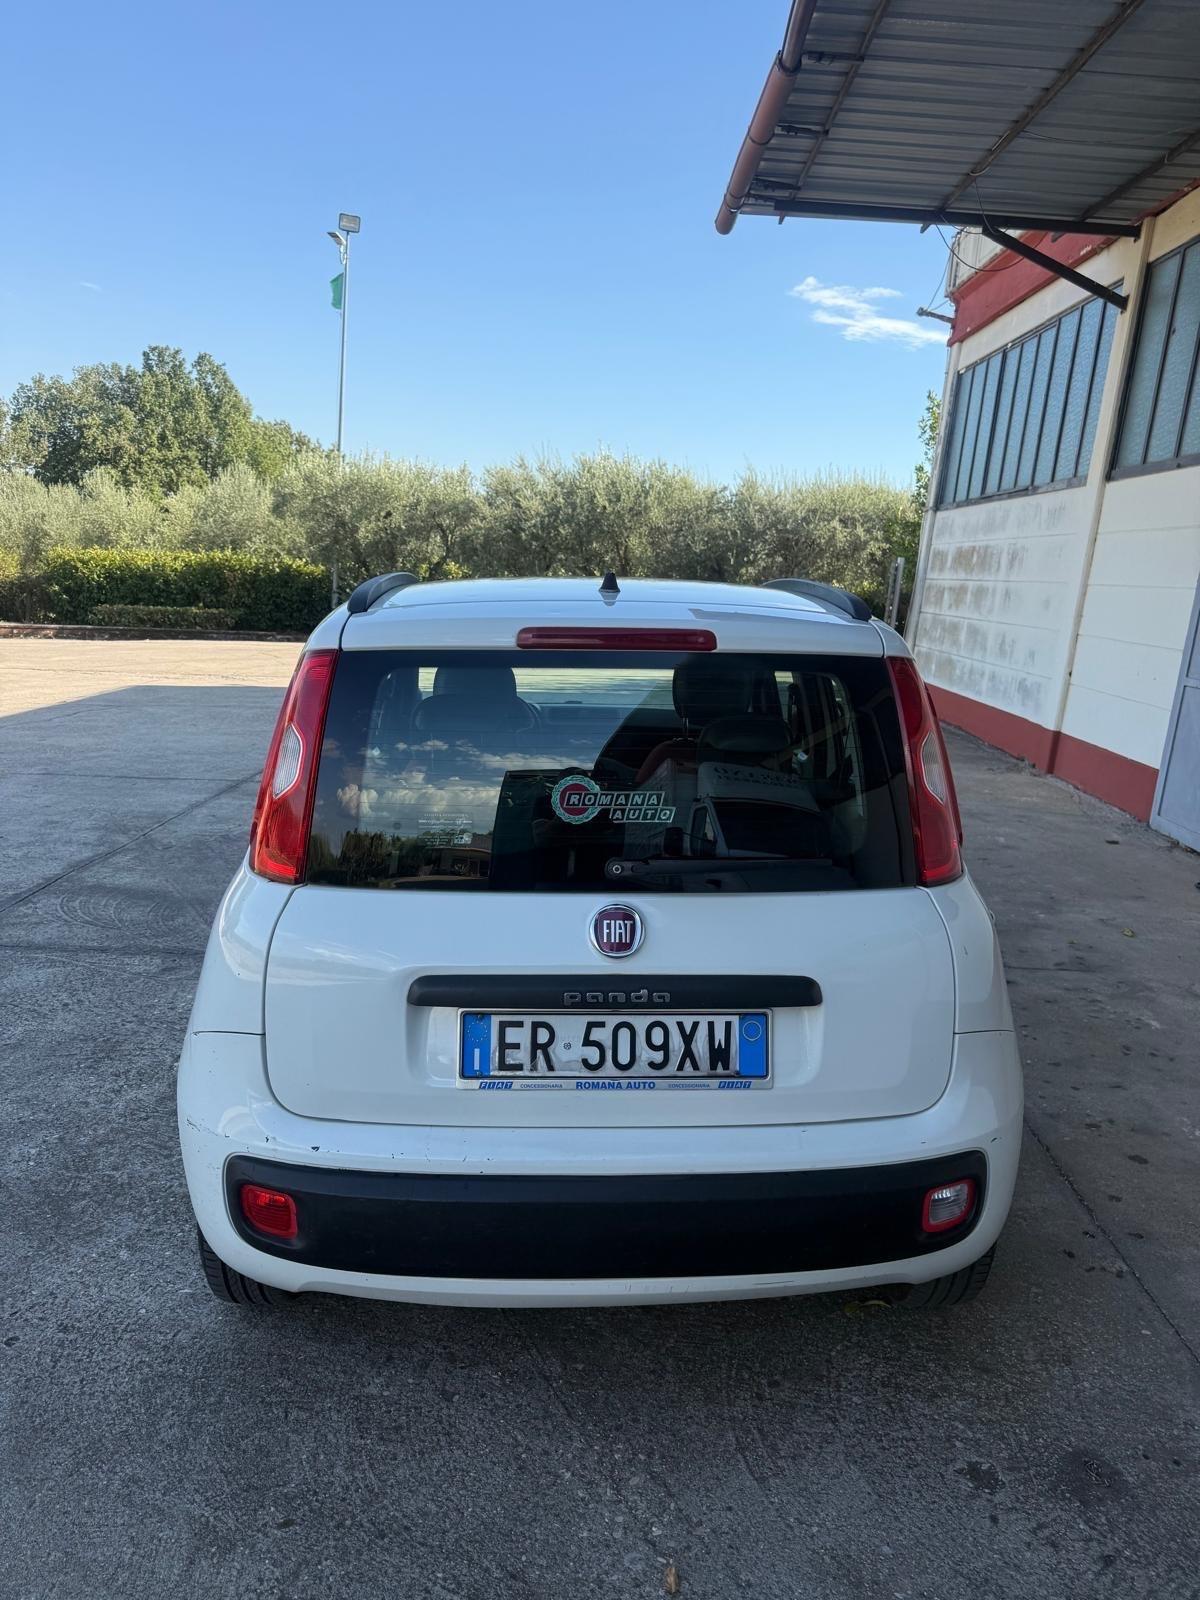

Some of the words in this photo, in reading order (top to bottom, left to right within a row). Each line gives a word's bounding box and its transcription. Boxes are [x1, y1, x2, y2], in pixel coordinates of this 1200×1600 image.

[568, 794, 659, 806] ROMANA
[612, 809, 671, 820] AUTO
[603, 919, 633, 943] FIAT
[563, 988, 671, 1006] panda
[498, 1020, 556, 1072] ER
[581, 1020, 732, 1072] 509XW
[479, 1081, 514, 1090] FIAT
[575, 1081, 622, 1090] ROMANA
[626, 1081, 656, 1090] AUTO
[717, 1080, 753, 1089] FIAT
